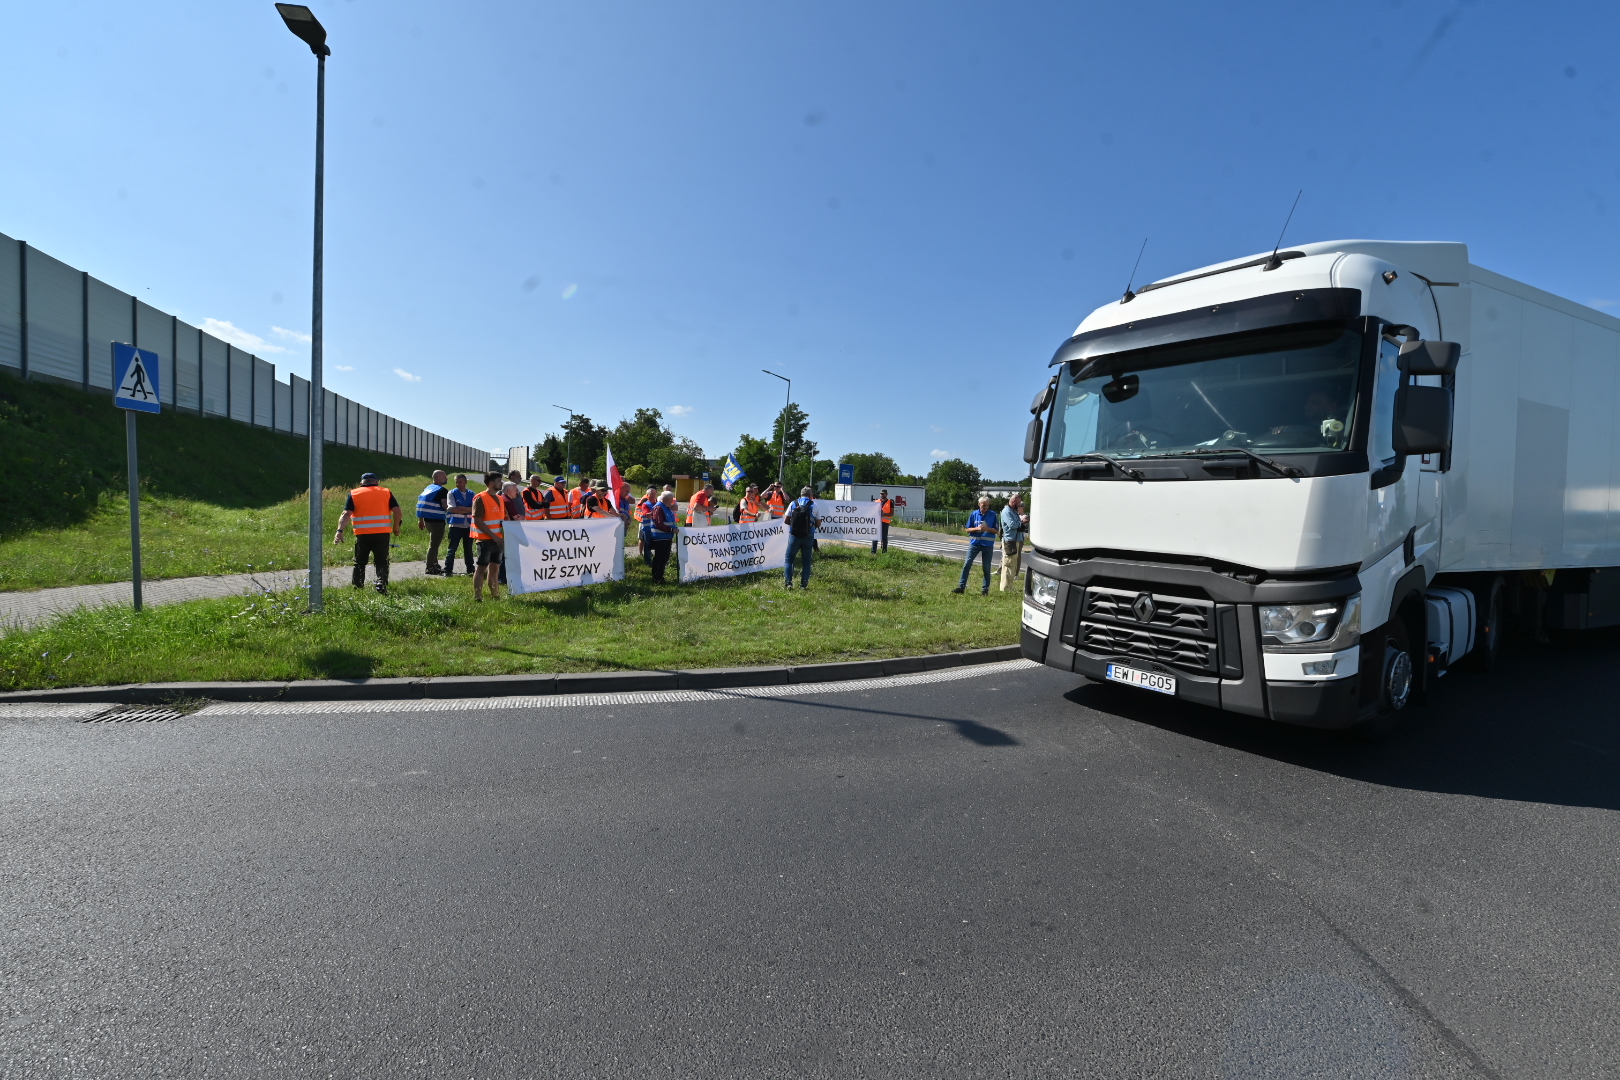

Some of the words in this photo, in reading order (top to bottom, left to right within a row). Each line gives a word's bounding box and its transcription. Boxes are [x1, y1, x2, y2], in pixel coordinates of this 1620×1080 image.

[835, 505, 858, 514] STOP
[820, 515, 876, 525] ROCEDEROWI
[546, 528, 590, 543] WOLĄ
[683, 532, 708, 546] DOŚĆ
[708, 525, 784, 544] FAWORYZOWANIA
[815, 526, 854, 535] WIJANIA
[855, 527, 878, 535] KOLEI
[541, 545, 596, 562] SPALINY
[709, 541, 765, 559] TRANSPORTU
[533, 564, 557, 582] NIŻ
[559, 562, 601, 578] SZYNY
[707, 555, 766, 573] DROGOWEGO
[1114, 666, 1135, 682] EWI
[1140, 672, 1172, 690] PG05
